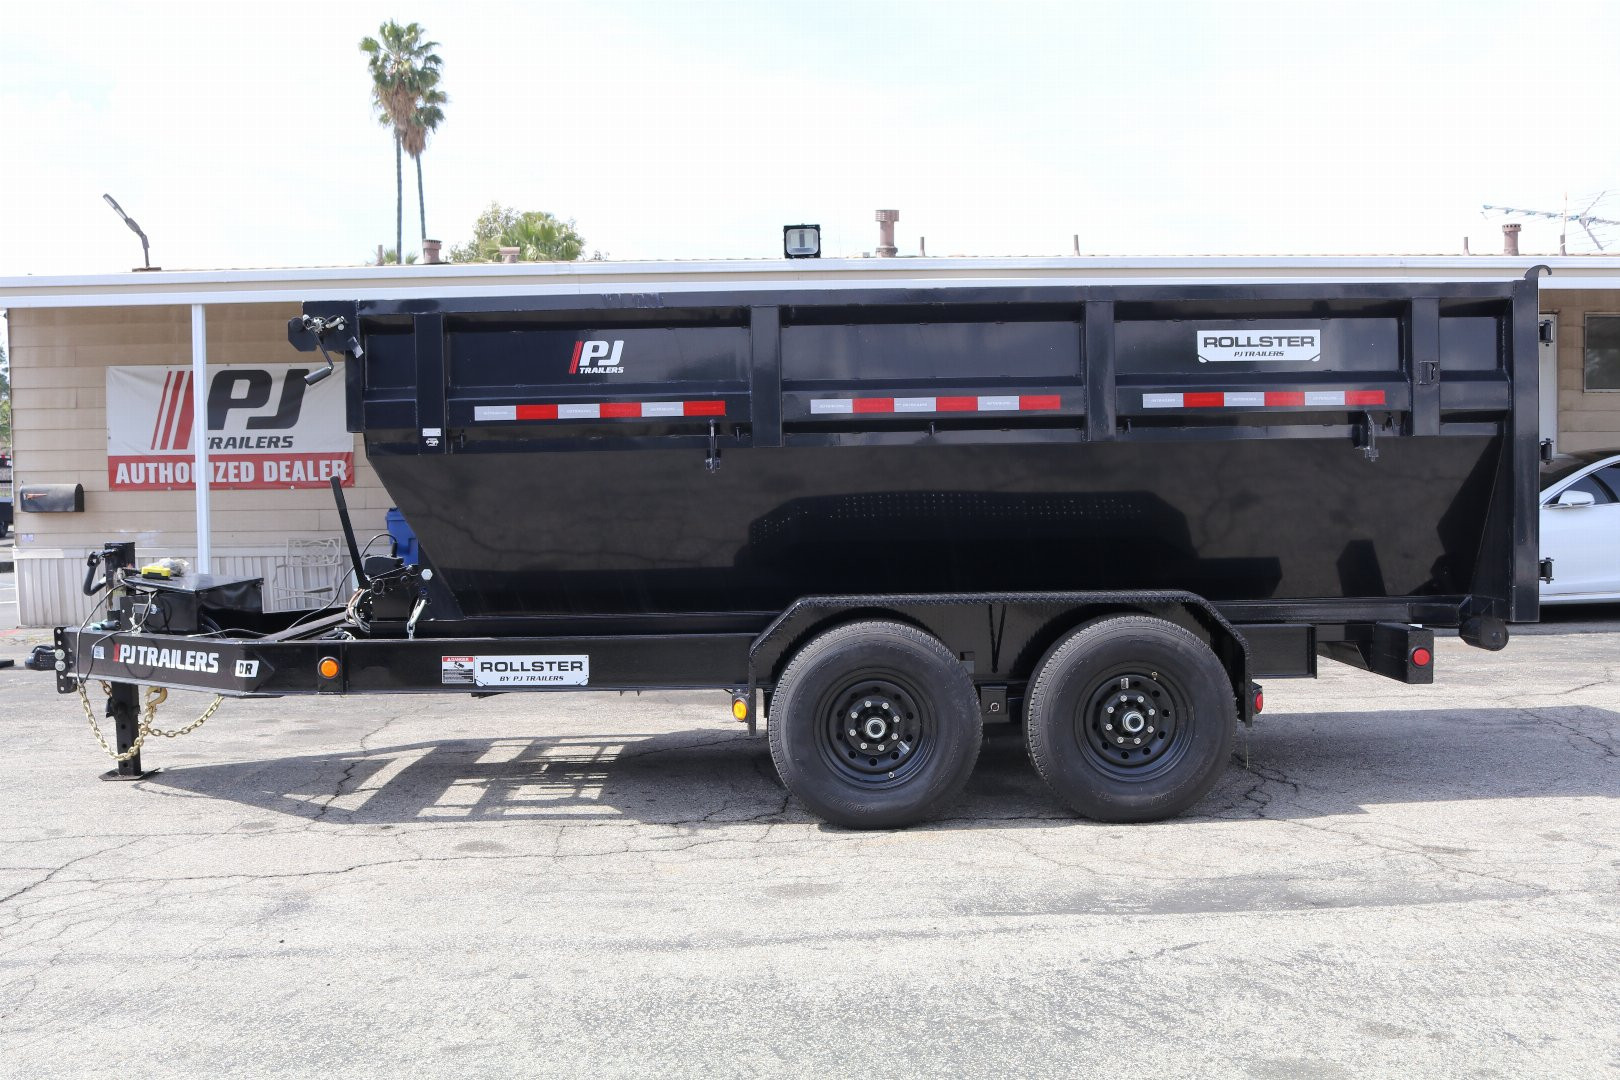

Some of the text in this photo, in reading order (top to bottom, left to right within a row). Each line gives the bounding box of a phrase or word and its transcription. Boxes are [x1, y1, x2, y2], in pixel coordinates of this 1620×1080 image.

[1203, 336, 1315, 348] ROLLSTER
[579, 340, 624, 366] PJ
[580, 366, 624, 374] TRAILERS
[207, 368, 309, 431] PJ
[207, 435, 294, 450] RAILERS
[115, 459, 347, 484] AUTHOIZED DEALER
[119, 644, 136, 664] PJ
[137, 645, 219, 674] TRAILERS
[480, 661, 583, 672] ROLLSTER
[239, 662, 253, 675] DR
